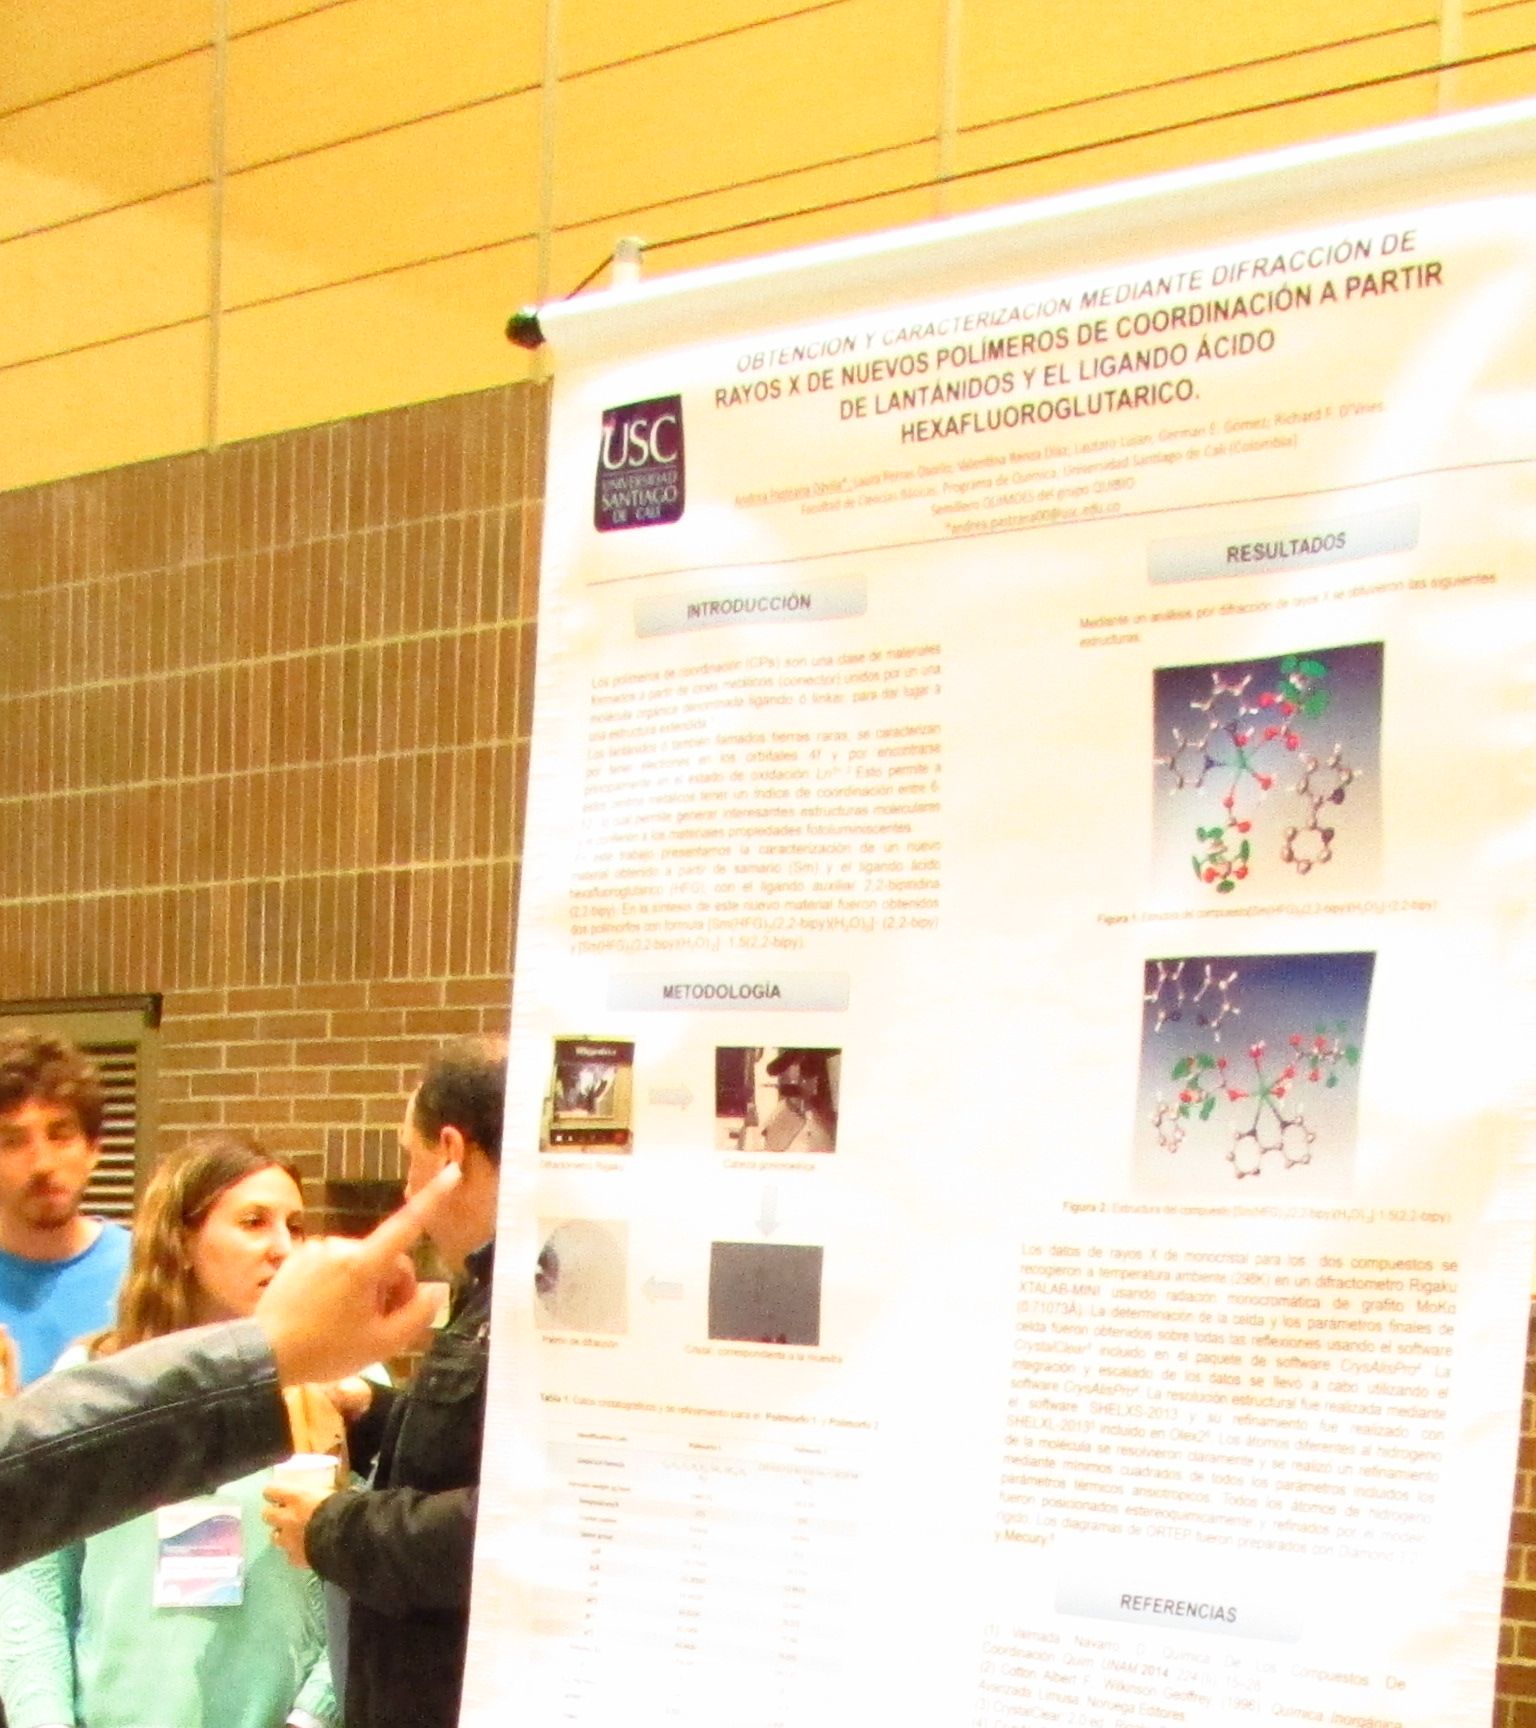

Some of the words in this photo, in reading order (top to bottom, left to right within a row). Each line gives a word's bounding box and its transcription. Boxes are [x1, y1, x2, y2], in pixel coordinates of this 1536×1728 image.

[864, 331, 875, 349] Y
[1078, 269, 1202, 311] MEDIANTE
[1379, 228, 1417, 258] DE
[712, 376, 783, 410] RAYOS
[787, 375, 802, 396] X
[805, 367, 835, 394] DE
[839, 349, 930, 389] NUEVOS
[934, 325, 1071, 372] POLÍMEROS
[1074, 317, 1109, 348] DE
[1113, 281, 1314, 341] COORDINACIÓN
[1318, 278, 1339, 305] A
[1343, 258, 1446, 303] PARTIR
[837, 394, 868, 422] DE
[873, 369, 1015, 416] LANTÁNIDOS
[1020, 366, 1036, 390] Y
[1041, 360, 1071, 388] EL
[1076, 340, 1189, 383] LIGANDO
[1194, 325, 1277, 364] ÁCIDO
[899, 374, 1202, 446] HEXAFLUOROGLUTARICO.
[602, 414, 677, 470] USC
[602, 485, 677, 511] SANTIAGO
[1226, 530, 1346, 563] RESULTADOS
[687, 592, 812, 620] INTRODUCCIÓN
[662, 980, 782, 1000] METODOLOGÍA
[1349, 1256, 1436, 1272] compuestos
[1119, 1593, 1238, 1624] REFERENCIAS
